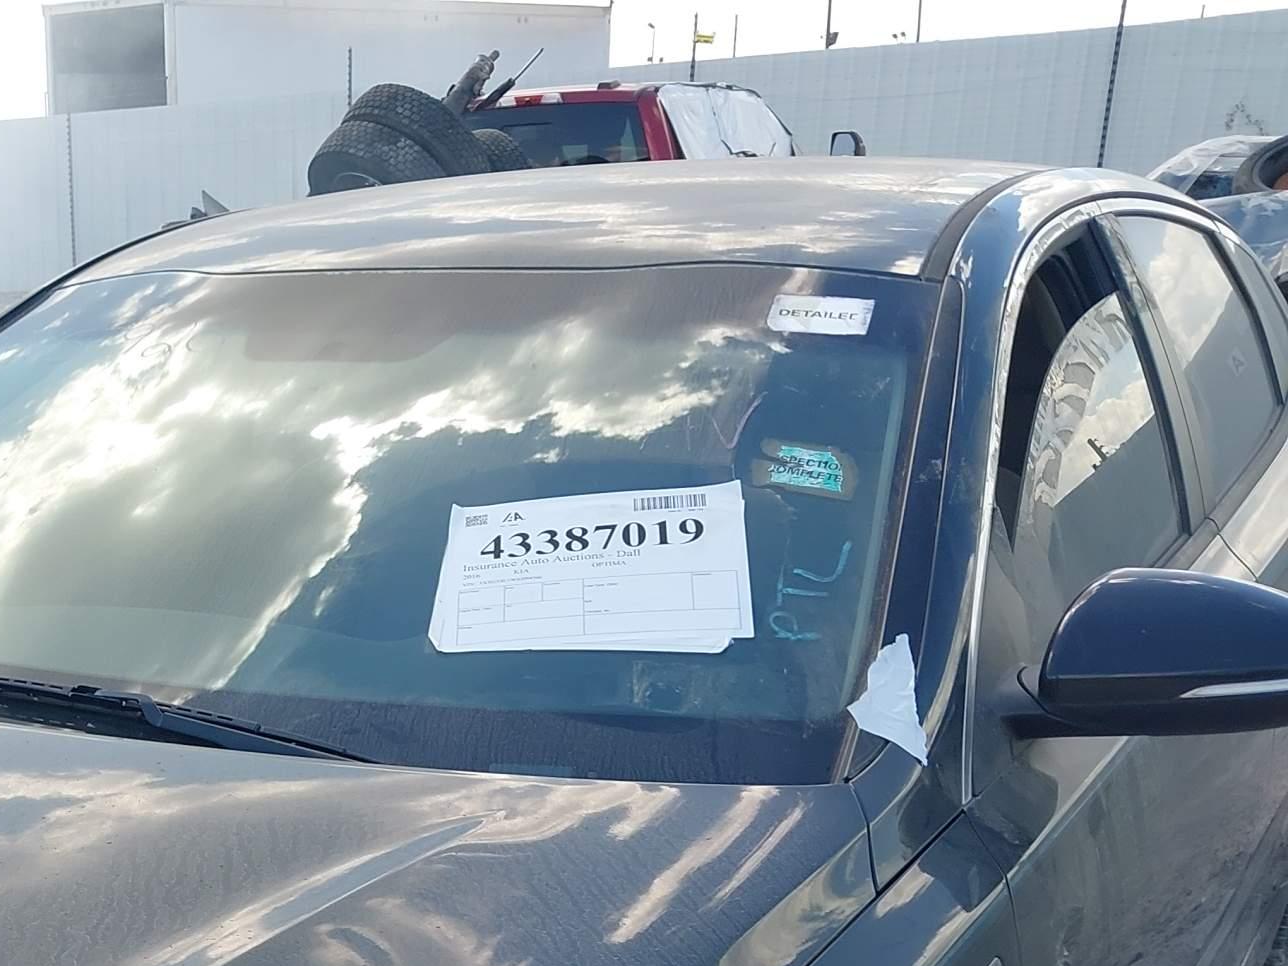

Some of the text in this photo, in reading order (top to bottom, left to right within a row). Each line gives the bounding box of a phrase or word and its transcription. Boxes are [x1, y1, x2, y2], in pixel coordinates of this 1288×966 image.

[479, 517, 706, 560] 43387019
[462, 560, 517, 572] Insurance
[520, 557, 549, 568] Auto
[553, 552, 605, 564] Auctions
[616, 549, 641, 558] Dall
